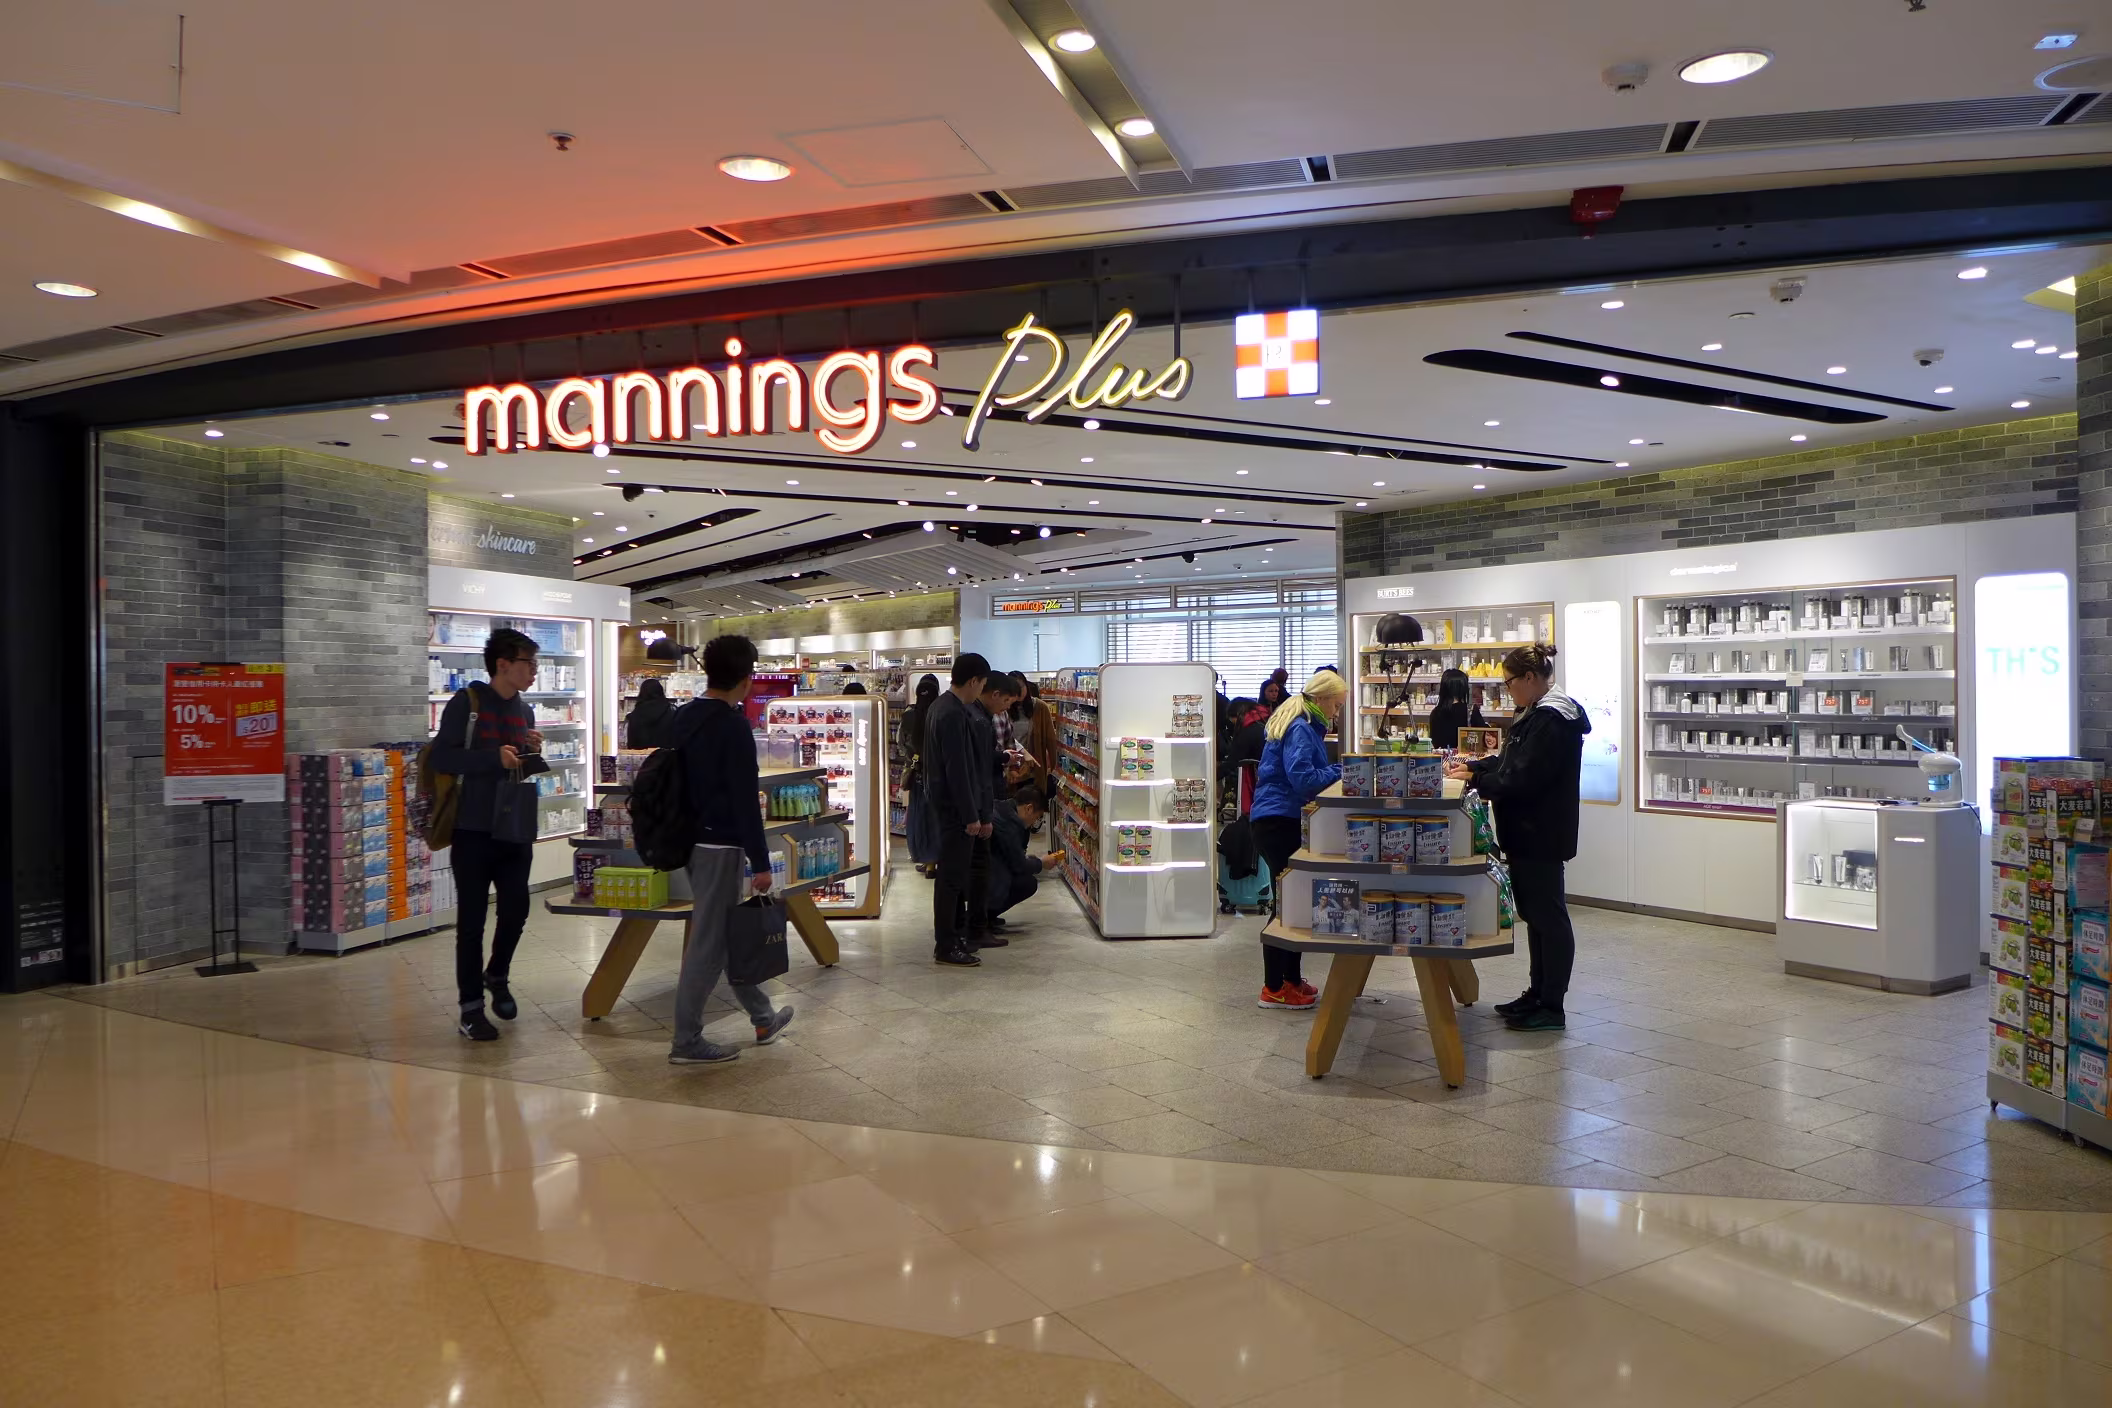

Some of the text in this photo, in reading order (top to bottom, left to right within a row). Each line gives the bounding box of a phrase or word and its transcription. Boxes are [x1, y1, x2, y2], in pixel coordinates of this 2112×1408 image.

[464, 309, 1192, 455] mannings Plus
[477, 525, 536, 555] skincare
[1002, 600, 1044, 612] mannings
[171, 704, 216, 724] 10%
[180, 734, 204, 749] 5%
